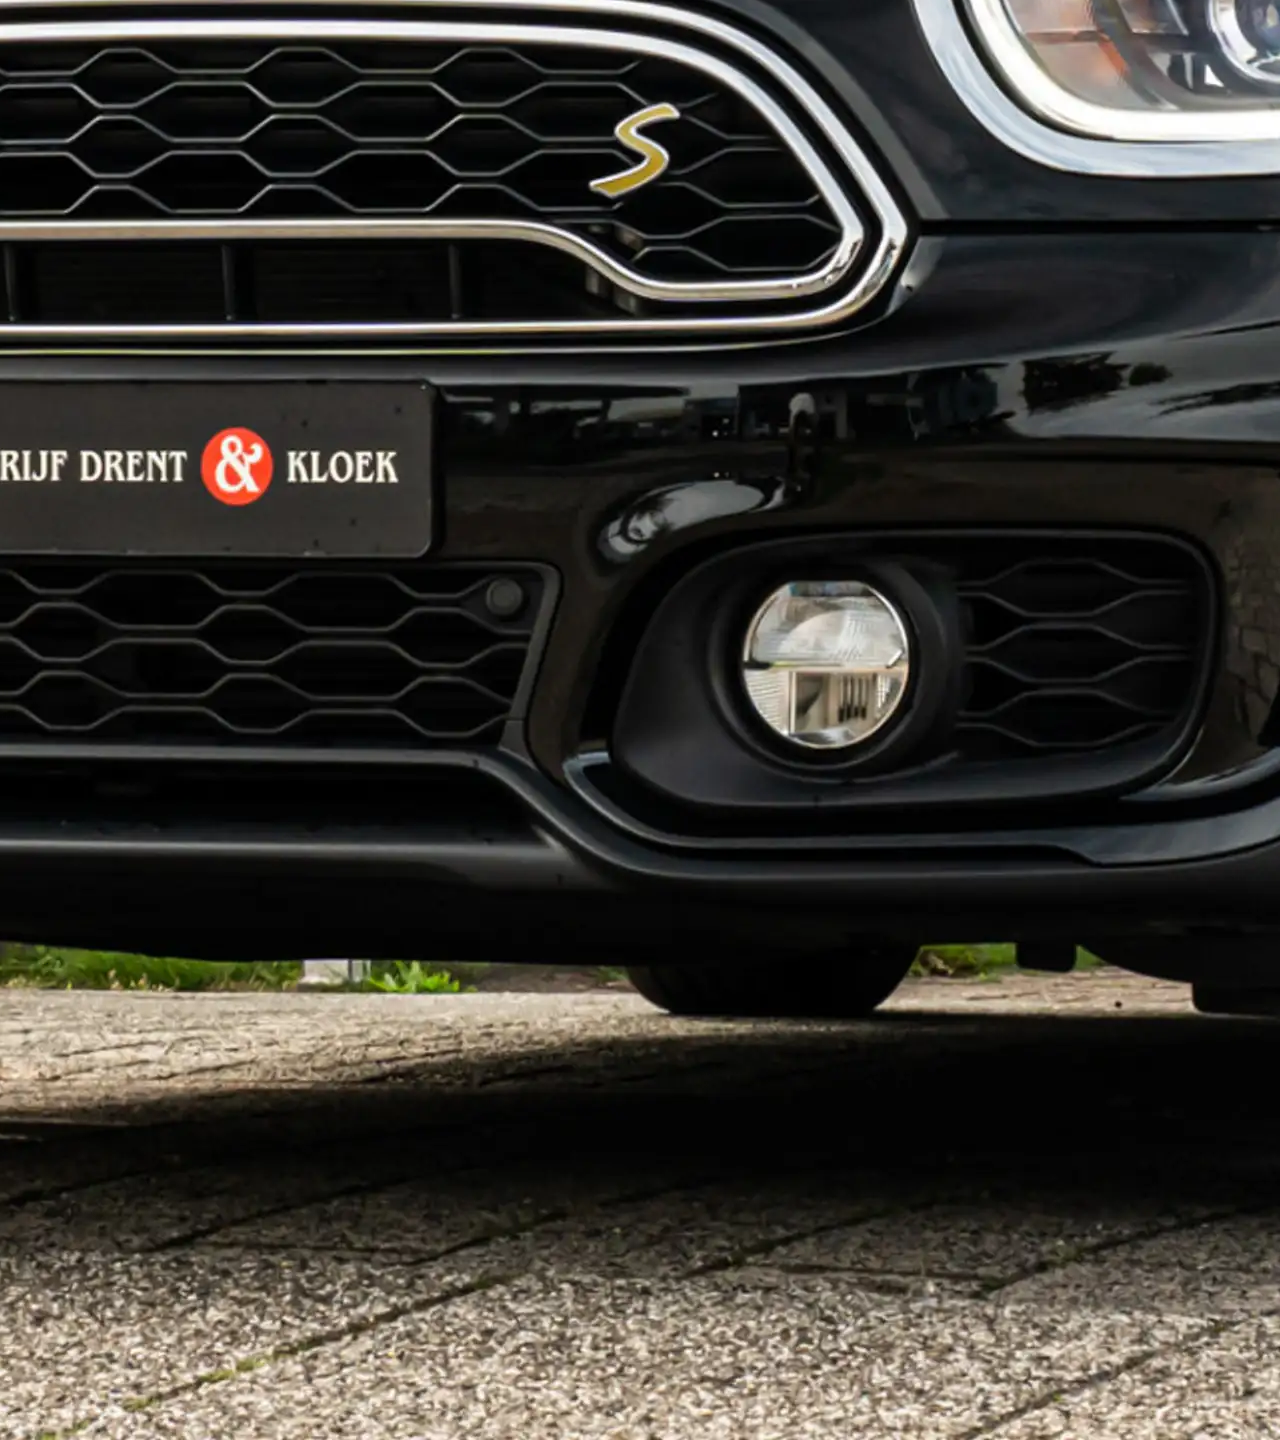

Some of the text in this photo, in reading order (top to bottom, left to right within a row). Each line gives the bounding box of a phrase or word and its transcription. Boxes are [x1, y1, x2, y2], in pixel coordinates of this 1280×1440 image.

[588, 102, 681, 199] S
[79, 449, 188, 482] DRENT
[214, 434, 263, 493] &
[286, 450, 399, 484] KLOEK
